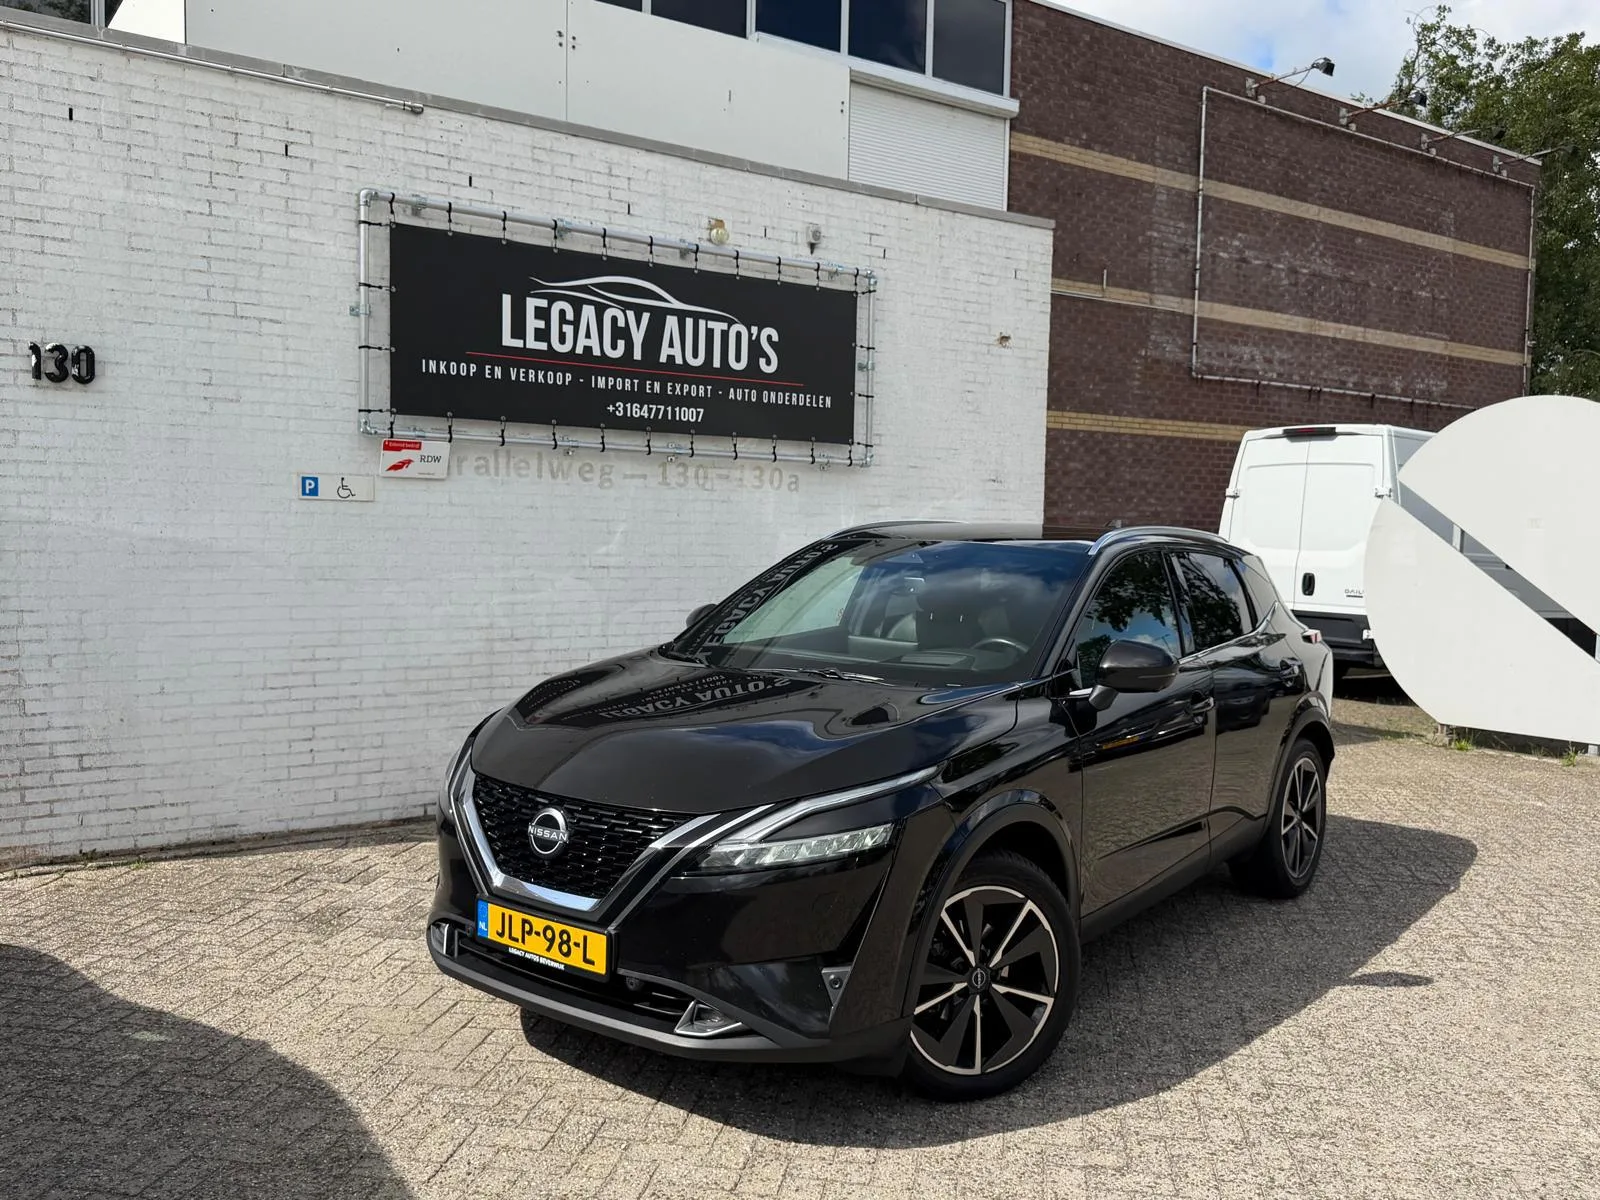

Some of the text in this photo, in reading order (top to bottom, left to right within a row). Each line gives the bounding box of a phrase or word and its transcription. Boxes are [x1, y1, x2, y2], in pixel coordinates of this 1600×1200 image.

[502, 293, 779, 374] LEGACY AUTO'S
[28, 341, 95, 385] 130
[422, 359, 477, 377] INKOOP
[485, 365, 502, 380] EN
[510, 367, 572, 386] VERKOOP
[591, 375, 639, 392] IMPORT
[646, 380, 661, 394] EN
[667, 382, 713, 398] EXPORT
[729, 387, 757, 402] AUTO
[762, 390, 832, 409] ONDERDELEN
[606, 401, 704, 423] +31647711007
[419, 455, 441, 463] RDW
[456, 450, 614, 489] rallelweg
[305, 479, 316, 494] P
[528, 824, 568, 841] NISSAN
[479, 921, 487, 930] NL
[496, 911, 595, 966] JLP-98-L
